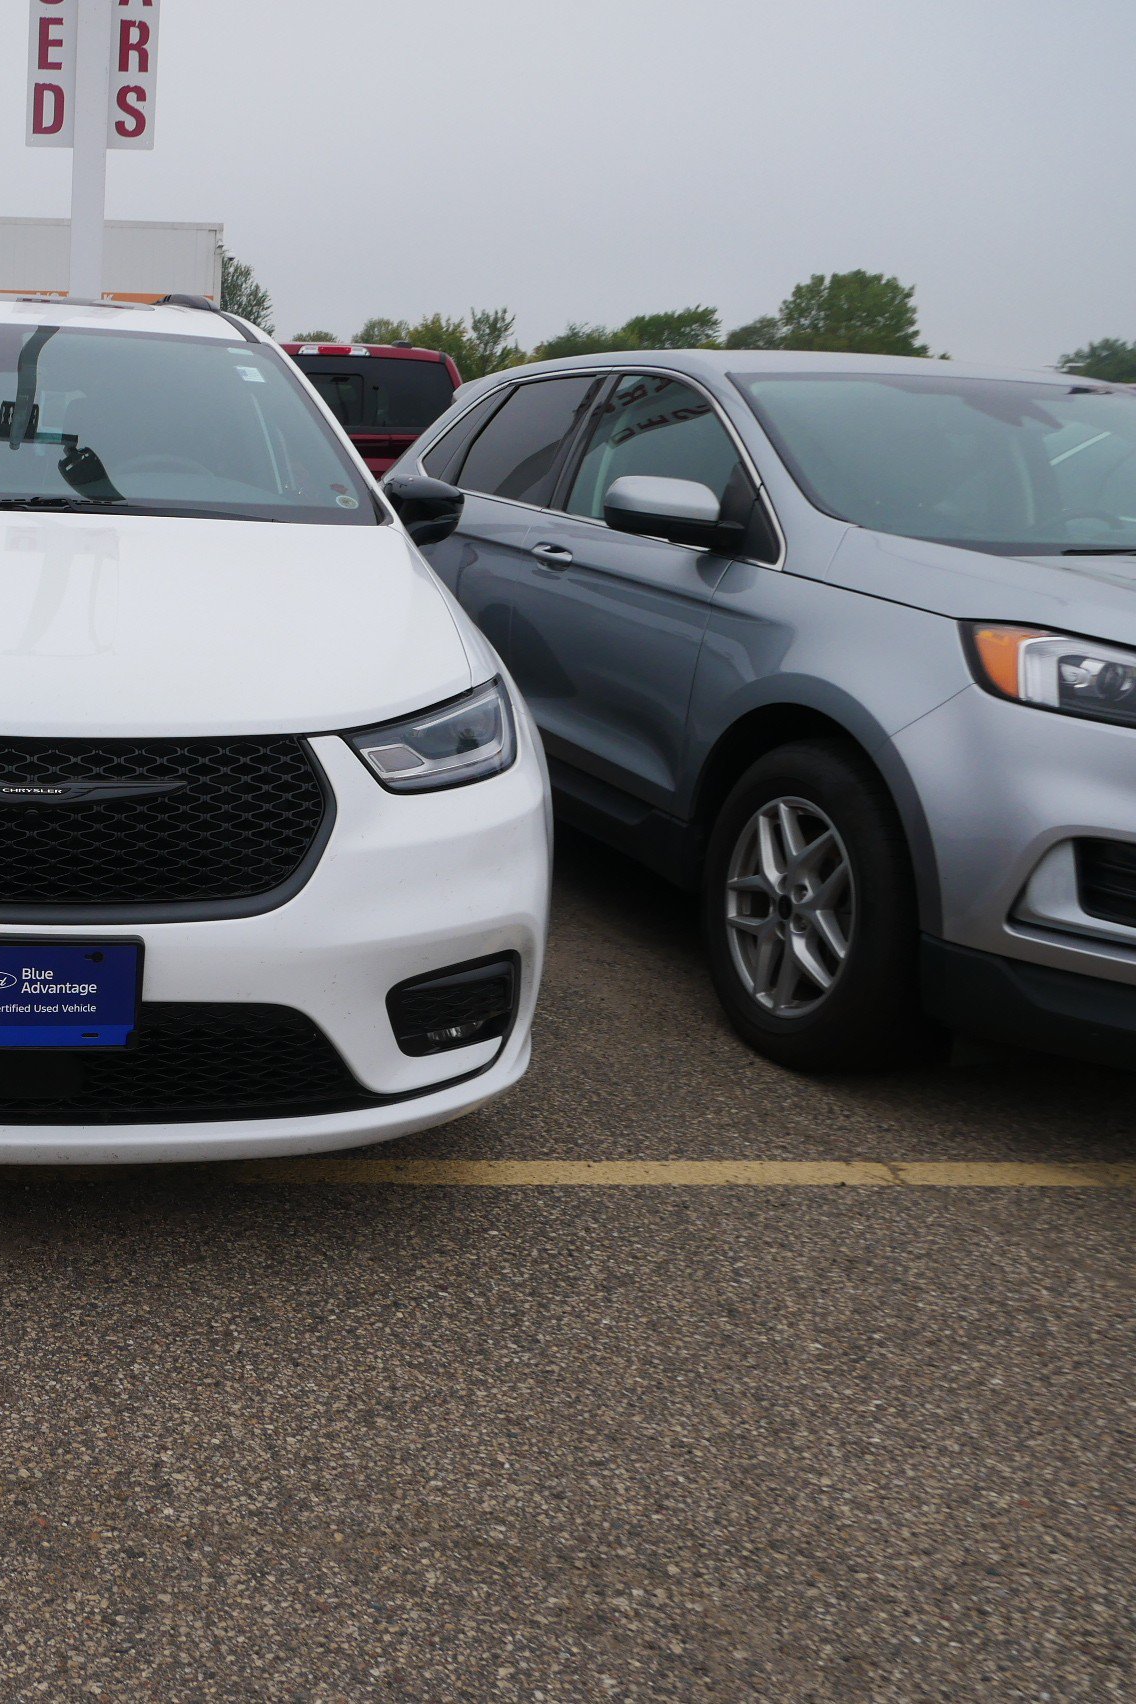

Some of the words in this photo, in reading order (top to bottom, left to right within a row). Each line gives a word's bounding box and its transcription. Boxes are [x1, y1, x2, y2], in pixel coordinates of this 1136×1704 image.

[32, 0, 65, 135] ED
[114, 0, 153, 138] RS
[2, 786, 63, 794] CHRYSLER
[21, 967, 54, 980] Blue
[20, 981, 97, 996] Advantage
[34, 1003, 59, 1013] Used
[62, 1004, 97, 1014] Vehicle
